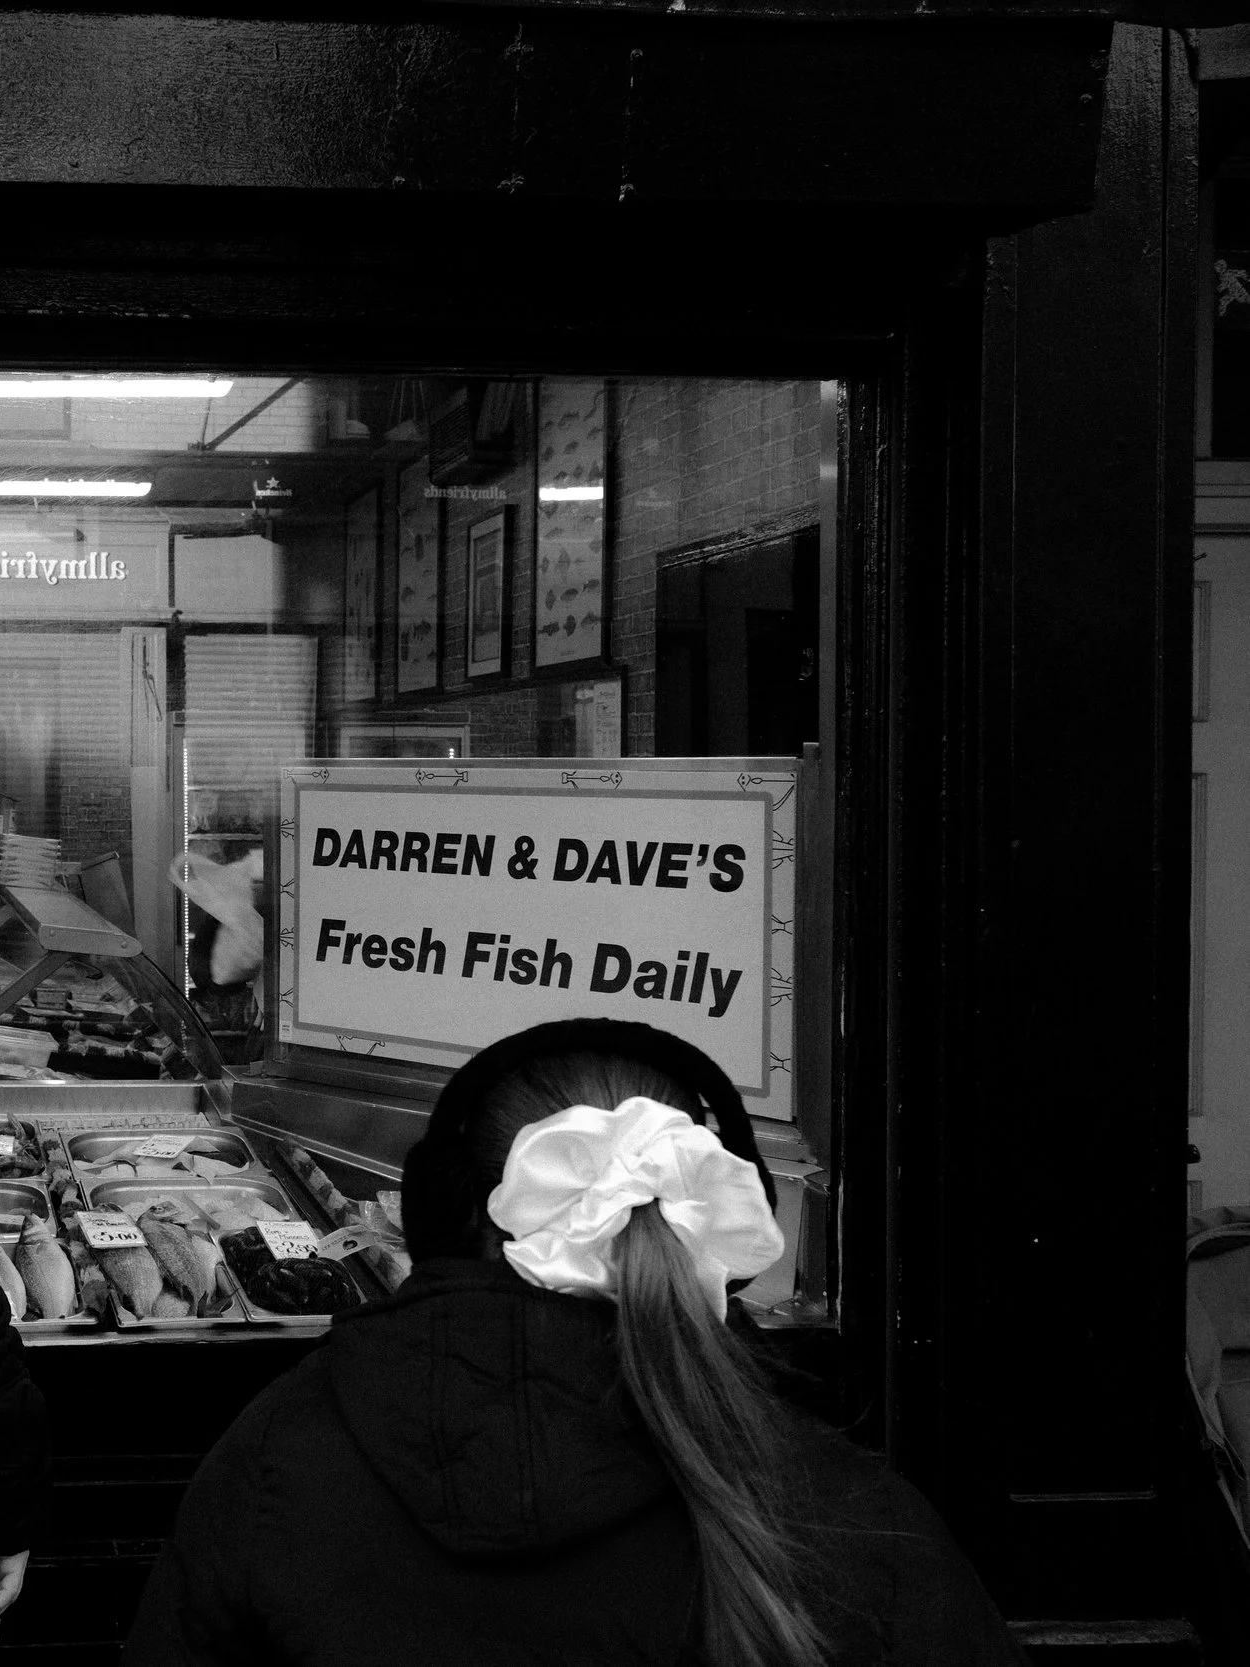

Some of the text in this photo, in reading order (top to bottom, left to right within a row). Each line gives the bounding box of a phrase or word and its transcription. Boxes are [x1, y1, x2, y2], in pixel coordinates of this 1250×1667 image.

[312, 827, 746, 893] DARREN & DAVE'S
[315, 918, 743, 1018] Fresh Fish Daily
